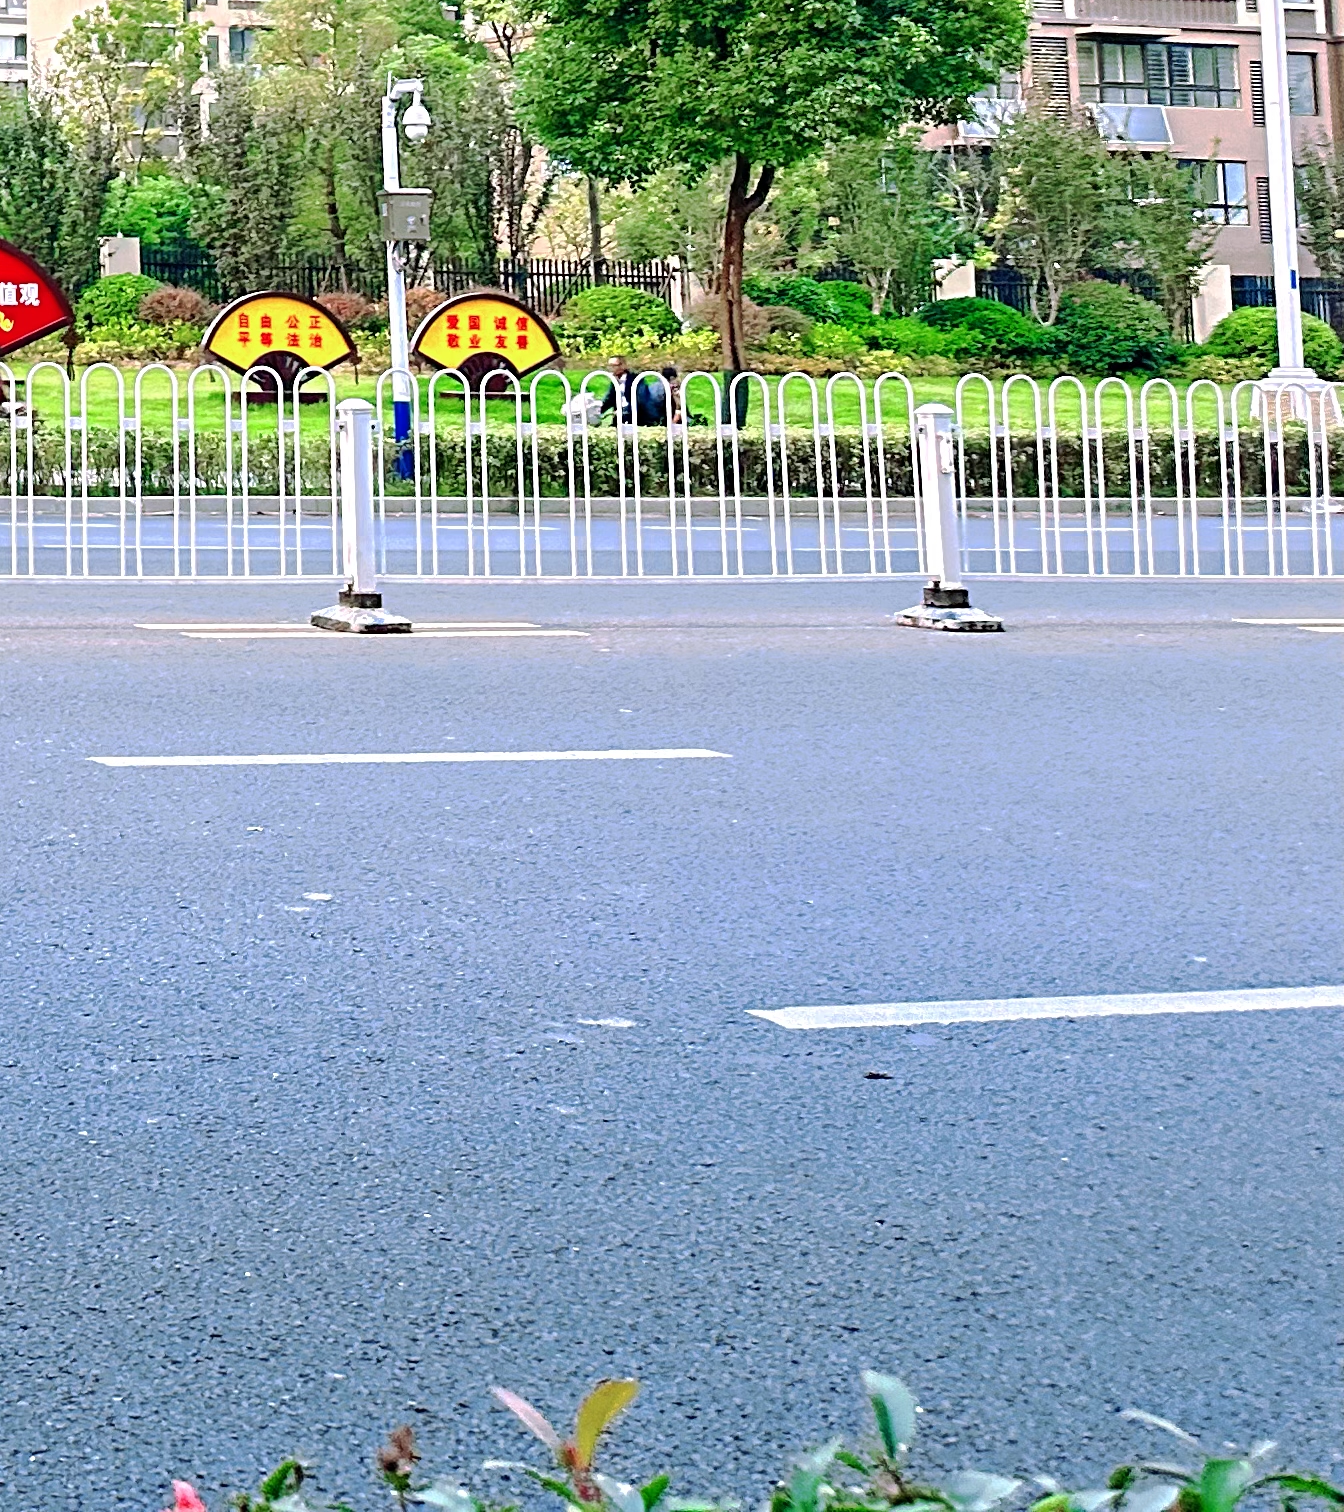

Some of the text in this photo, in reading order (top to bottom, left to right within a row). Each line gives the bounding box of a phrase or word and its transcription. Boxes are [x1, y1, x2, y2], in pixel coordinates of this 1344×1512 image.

[286, 314, 323, 330] 公正
[446, 314, 530, 332] 爱国 诚信
[237, 331, 324, 349] 平等 法治
[446, 333, 530, 350] 敬业 友善
